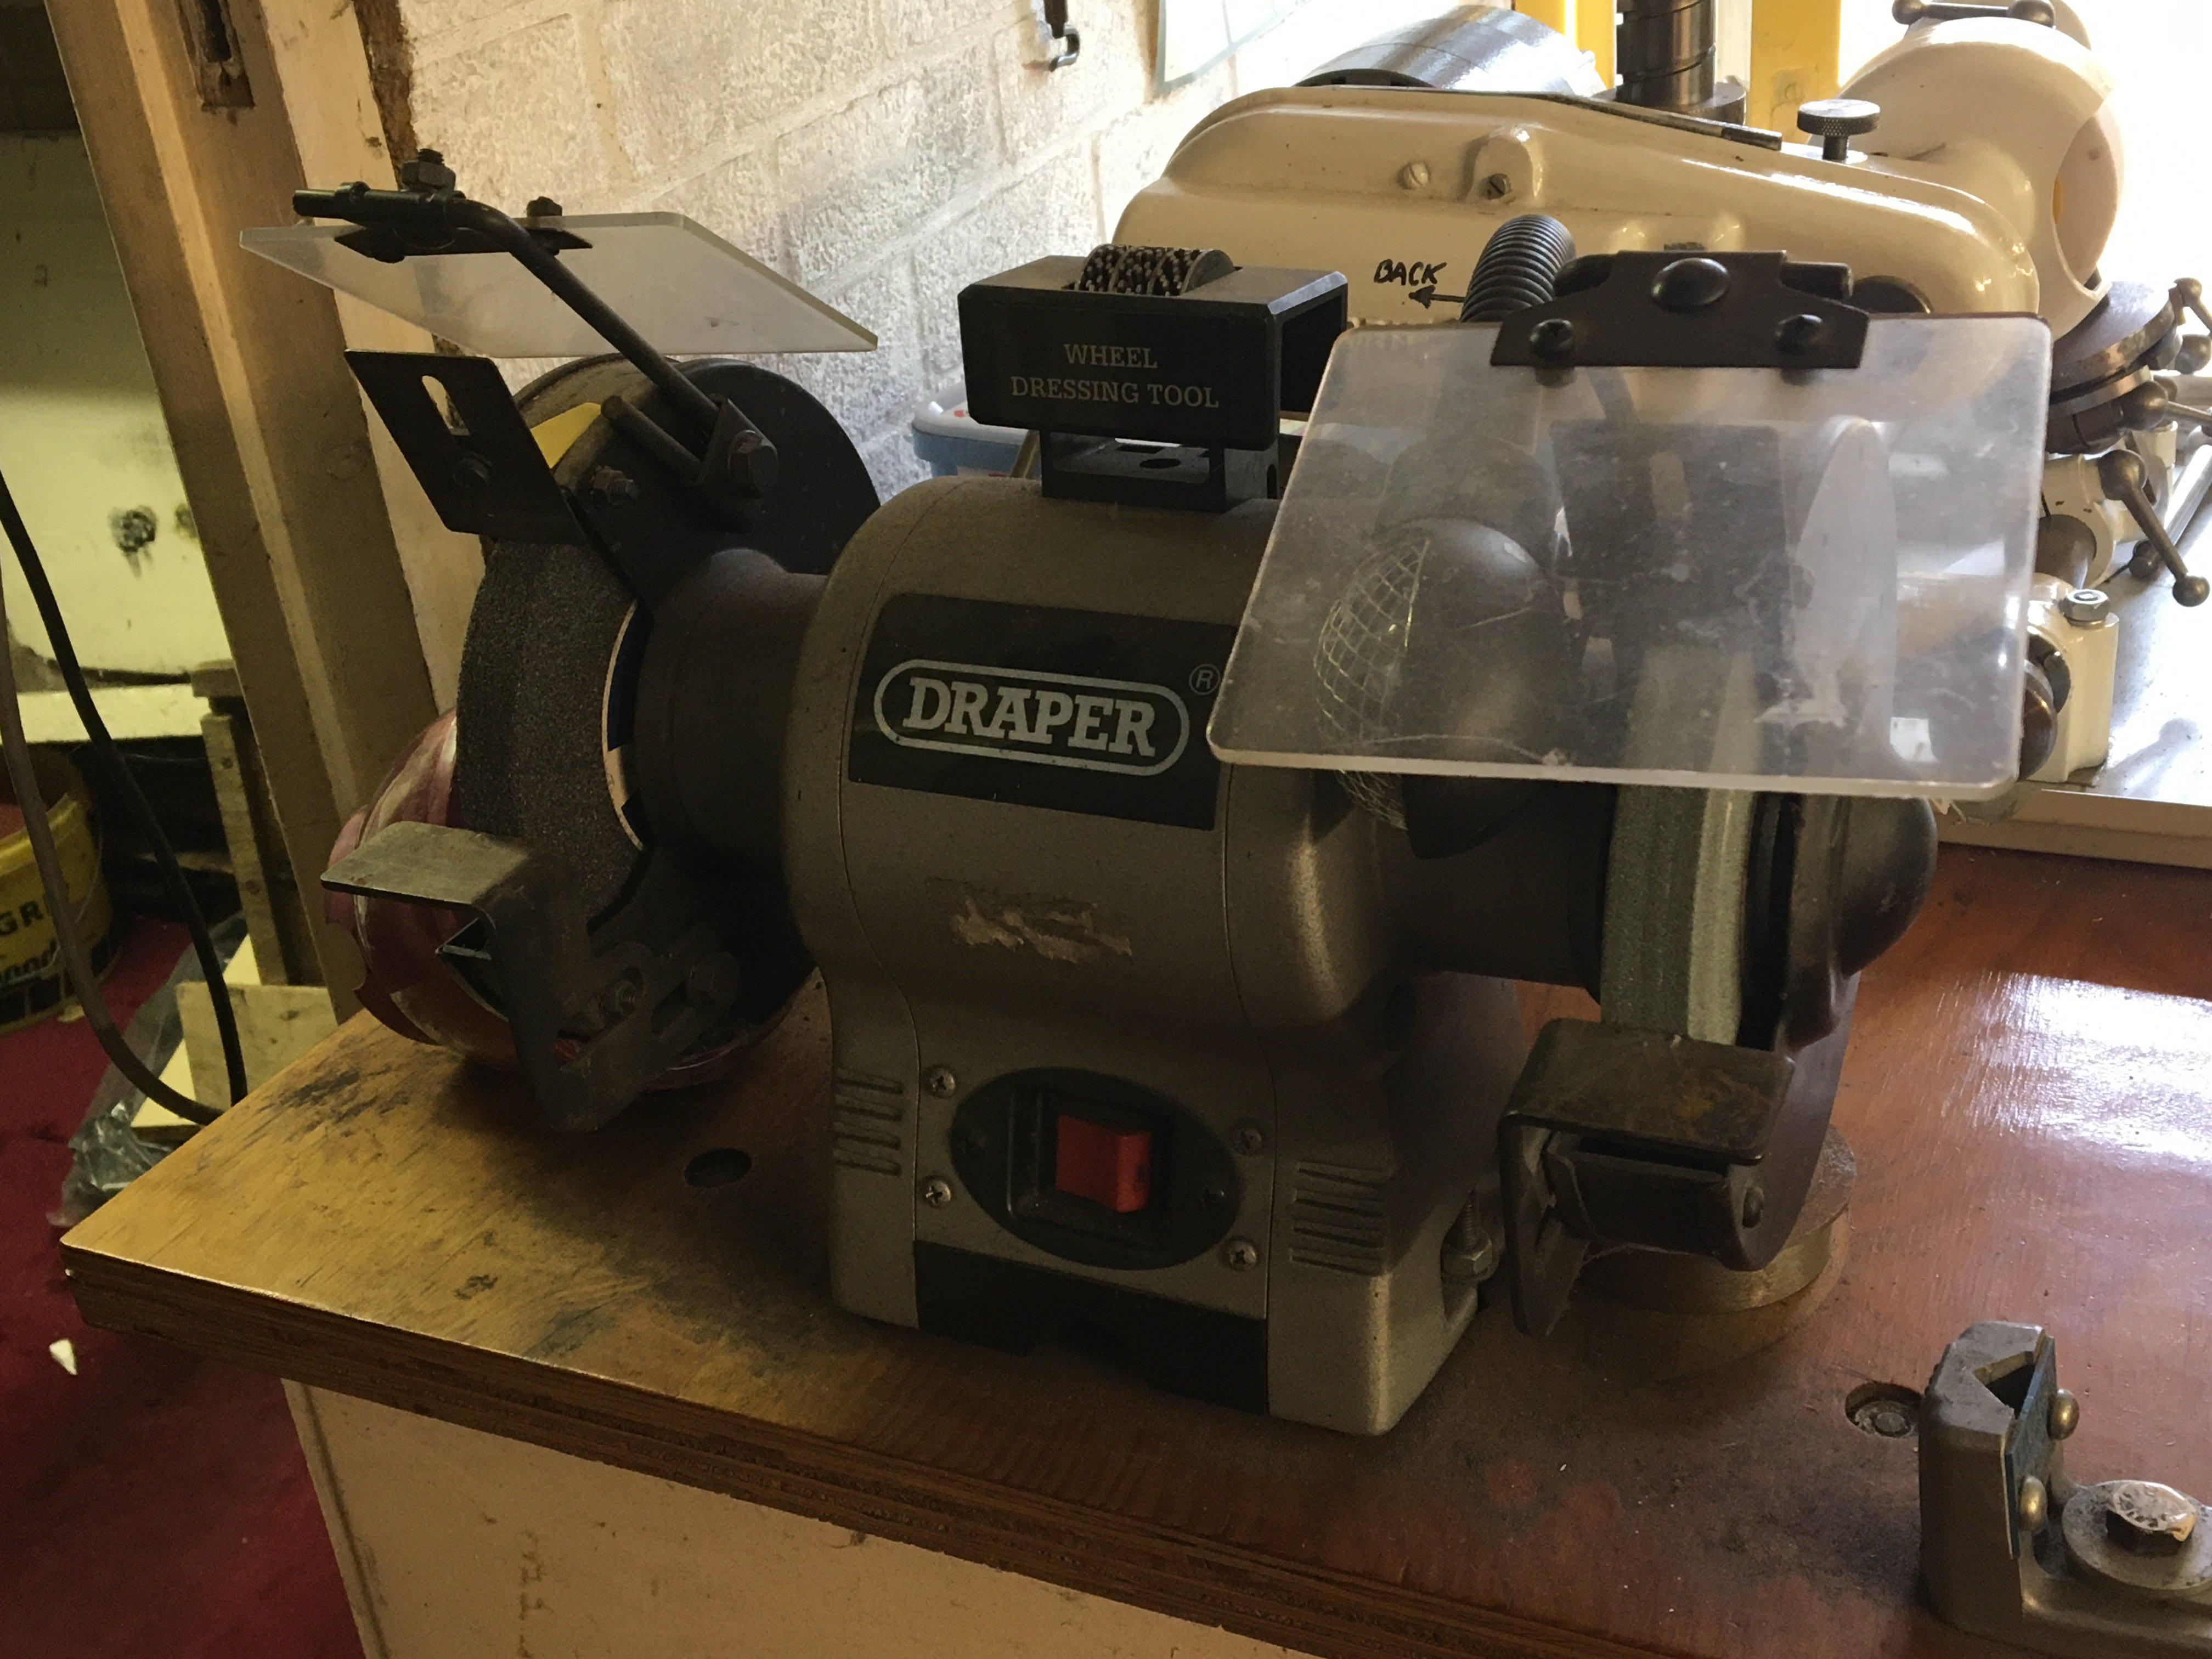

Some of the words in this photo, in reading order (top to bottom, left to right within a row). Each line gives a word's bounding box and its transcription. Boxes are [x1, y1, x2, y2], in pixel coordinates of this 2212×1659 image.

[1373, 258, 1448, 286] BACK
[1063, 343, 1159, 369] WHEEL
[1010, 376, 1140, 404] DRESSING
[1147, 383, 1220, 409] TOOL
[902, 676, 1156, 758] DRAPER
